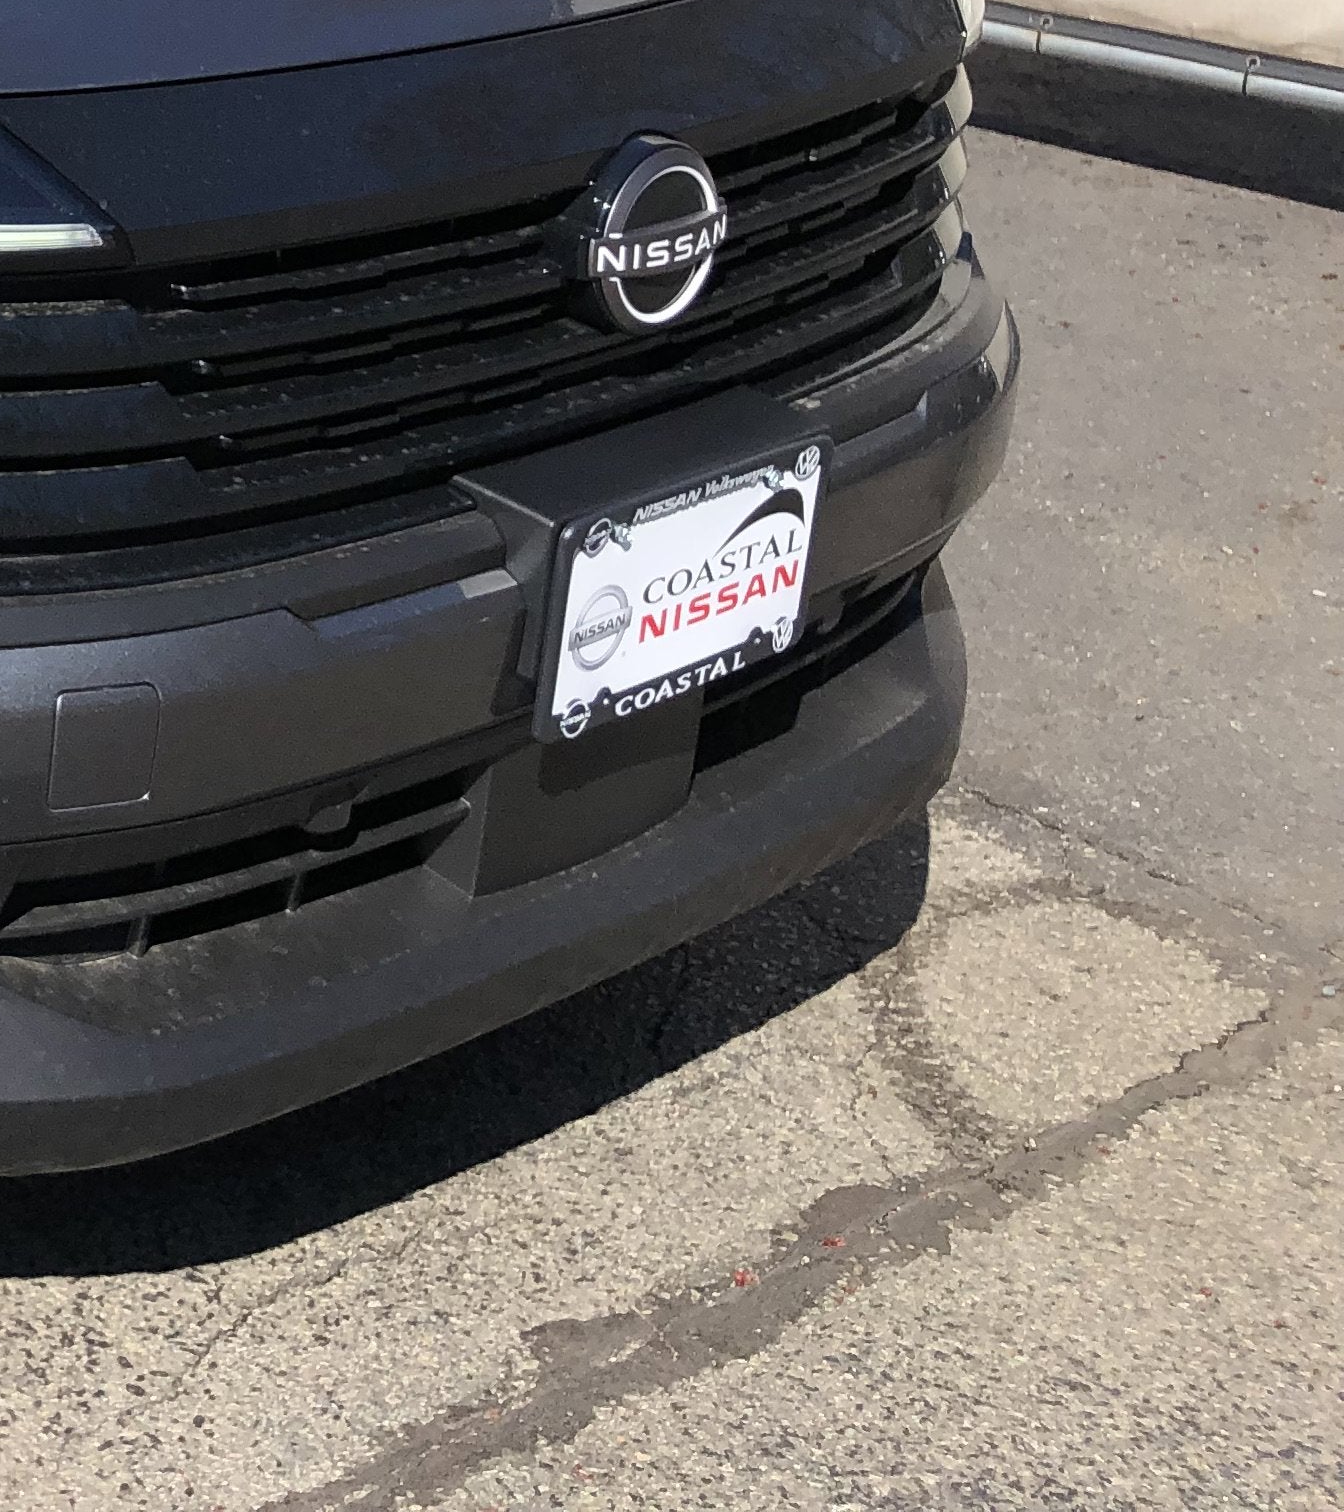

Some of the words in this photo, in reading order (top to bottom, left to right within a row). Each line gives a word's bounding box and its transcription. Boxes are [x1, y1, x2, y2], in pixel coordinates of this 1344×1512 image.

[596, 214, 728, 273] NISSAN
[633, 487, 703, 523] NISSAN
[642, 527, 803, 605] COASTAL
[573, 612, 627, 644] NISSAN
[638, 559, 799, 645] NISSAN
[614, 650, 746, 717] COASTAL
